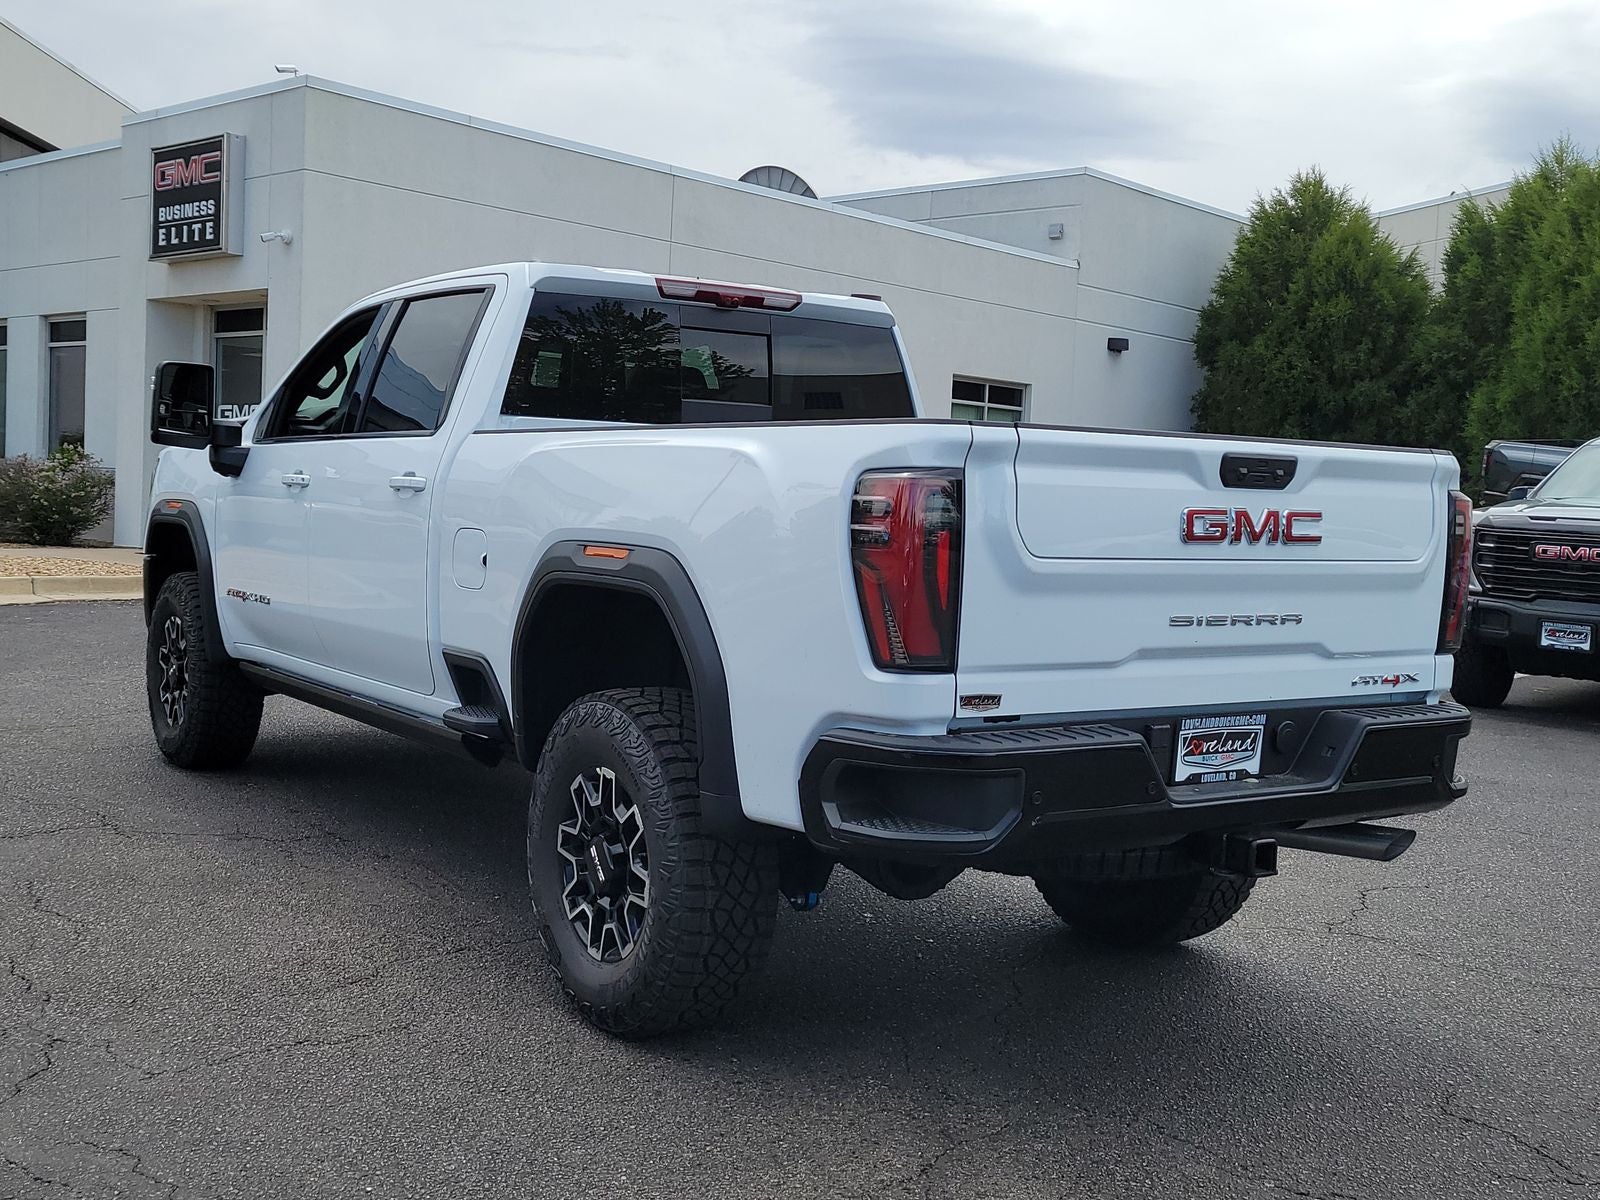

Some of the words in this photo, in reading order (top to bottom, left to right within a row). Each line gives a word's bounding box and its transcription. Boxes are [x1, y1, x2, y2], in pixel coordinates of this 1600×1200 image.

[155, 150, 221, 191] GMC
[158, 199, 215, 222] BUSINESS
[158, 221, 214, 246] ELITE
[1180, 507, 1323, 546] GMC
[1169, 613, 1303, 627] SIERRA
[1351, 672, 1420, 688] AT4X
